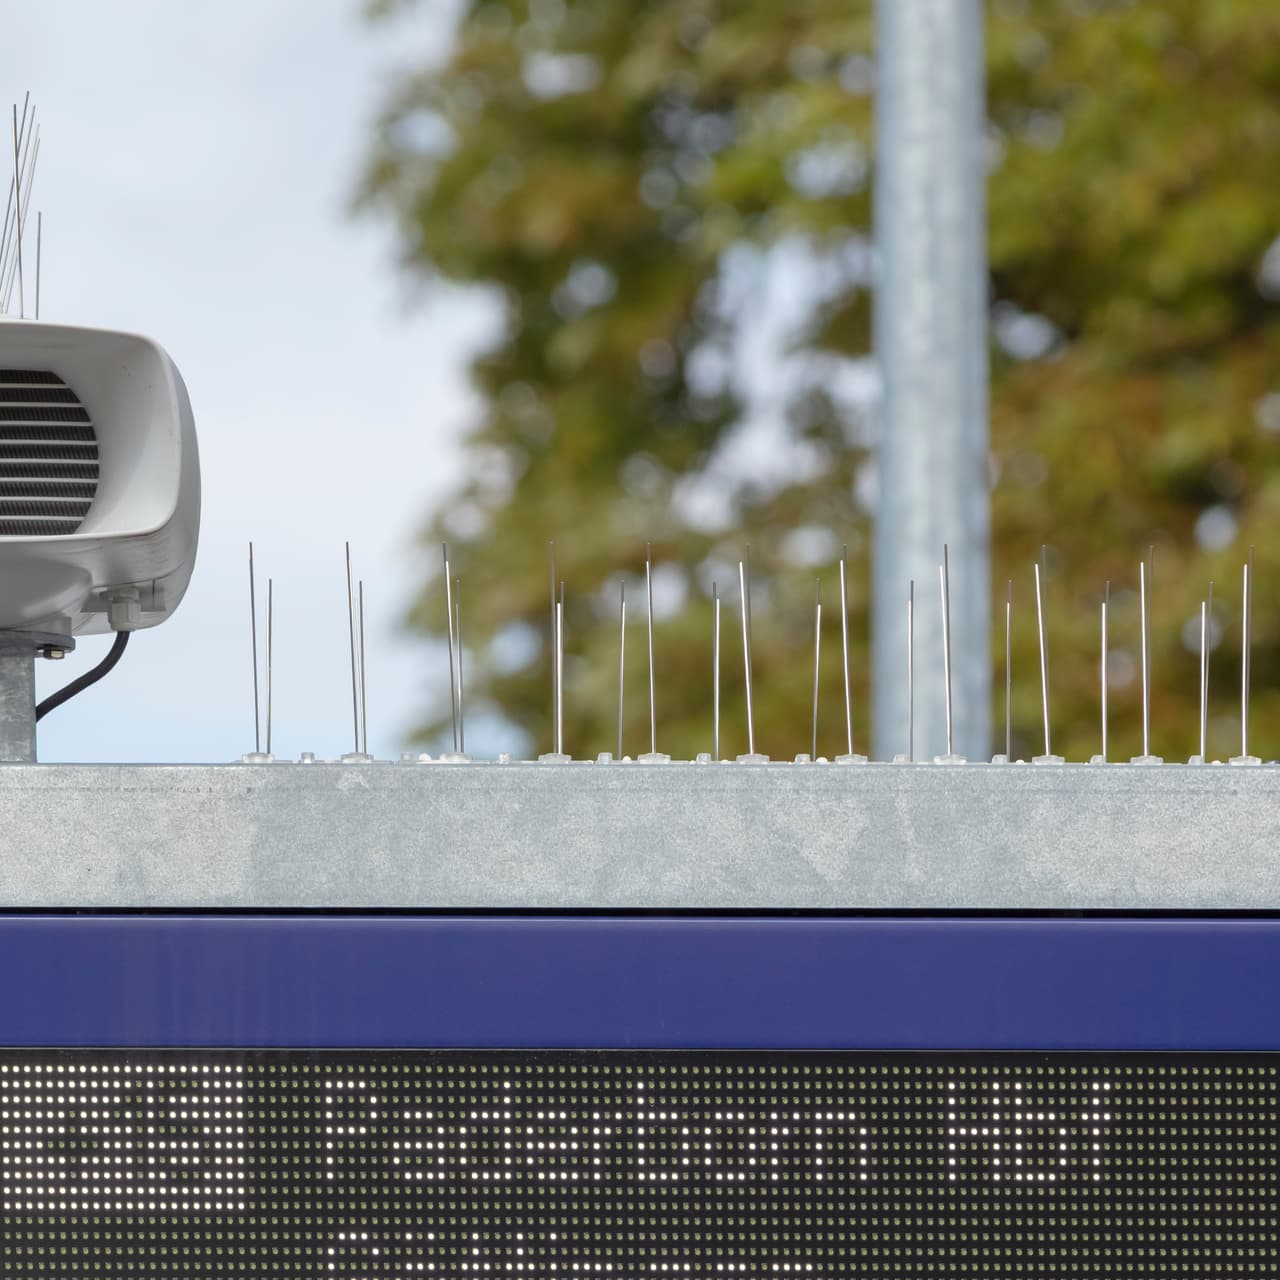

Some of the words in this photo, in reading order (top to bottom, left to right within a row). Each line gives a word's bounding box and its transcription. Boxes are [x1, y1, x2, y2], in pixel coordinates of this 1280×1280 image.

[40, 1077, 216, 1183] +15
[324, 1080, 868, 1181] Paderborn
[947, 1081, 1112, 1183] Hbf
